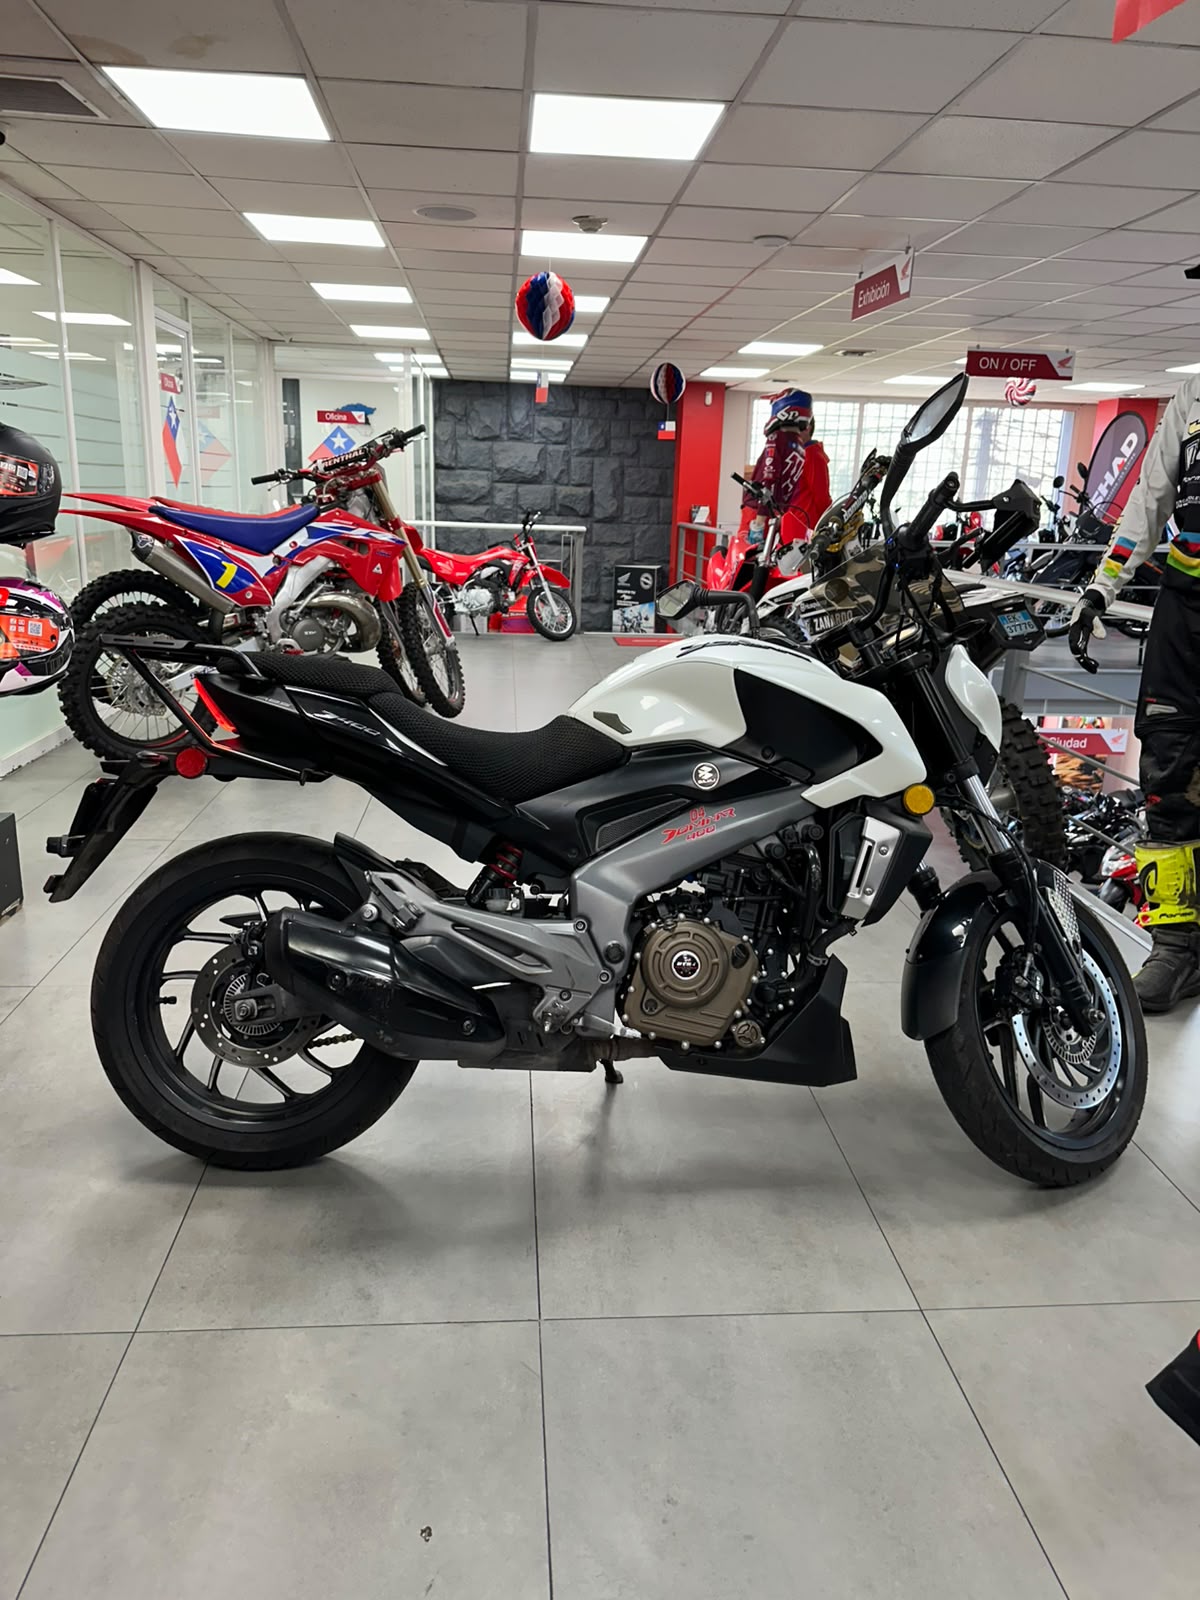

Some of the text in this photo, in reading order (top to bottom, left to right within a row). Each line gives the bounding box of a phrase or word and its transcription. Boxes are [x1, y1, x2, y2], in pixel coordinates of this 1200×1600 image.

[858, 280, 890, 308] Exhibición
[979, 356, 1038, 371] ON / OFF
[325, 412, 347, 422] Oficina
[1089, 432, 1139, 516] SHAD
[216, 560, 238, 588] 1
[1007, 613, 1018, 623] EK
[1006, 621, 1035, 634] 37776
[1047, 737, 1088, 749] Ciudad
[686, 825, 716, 842] 400
